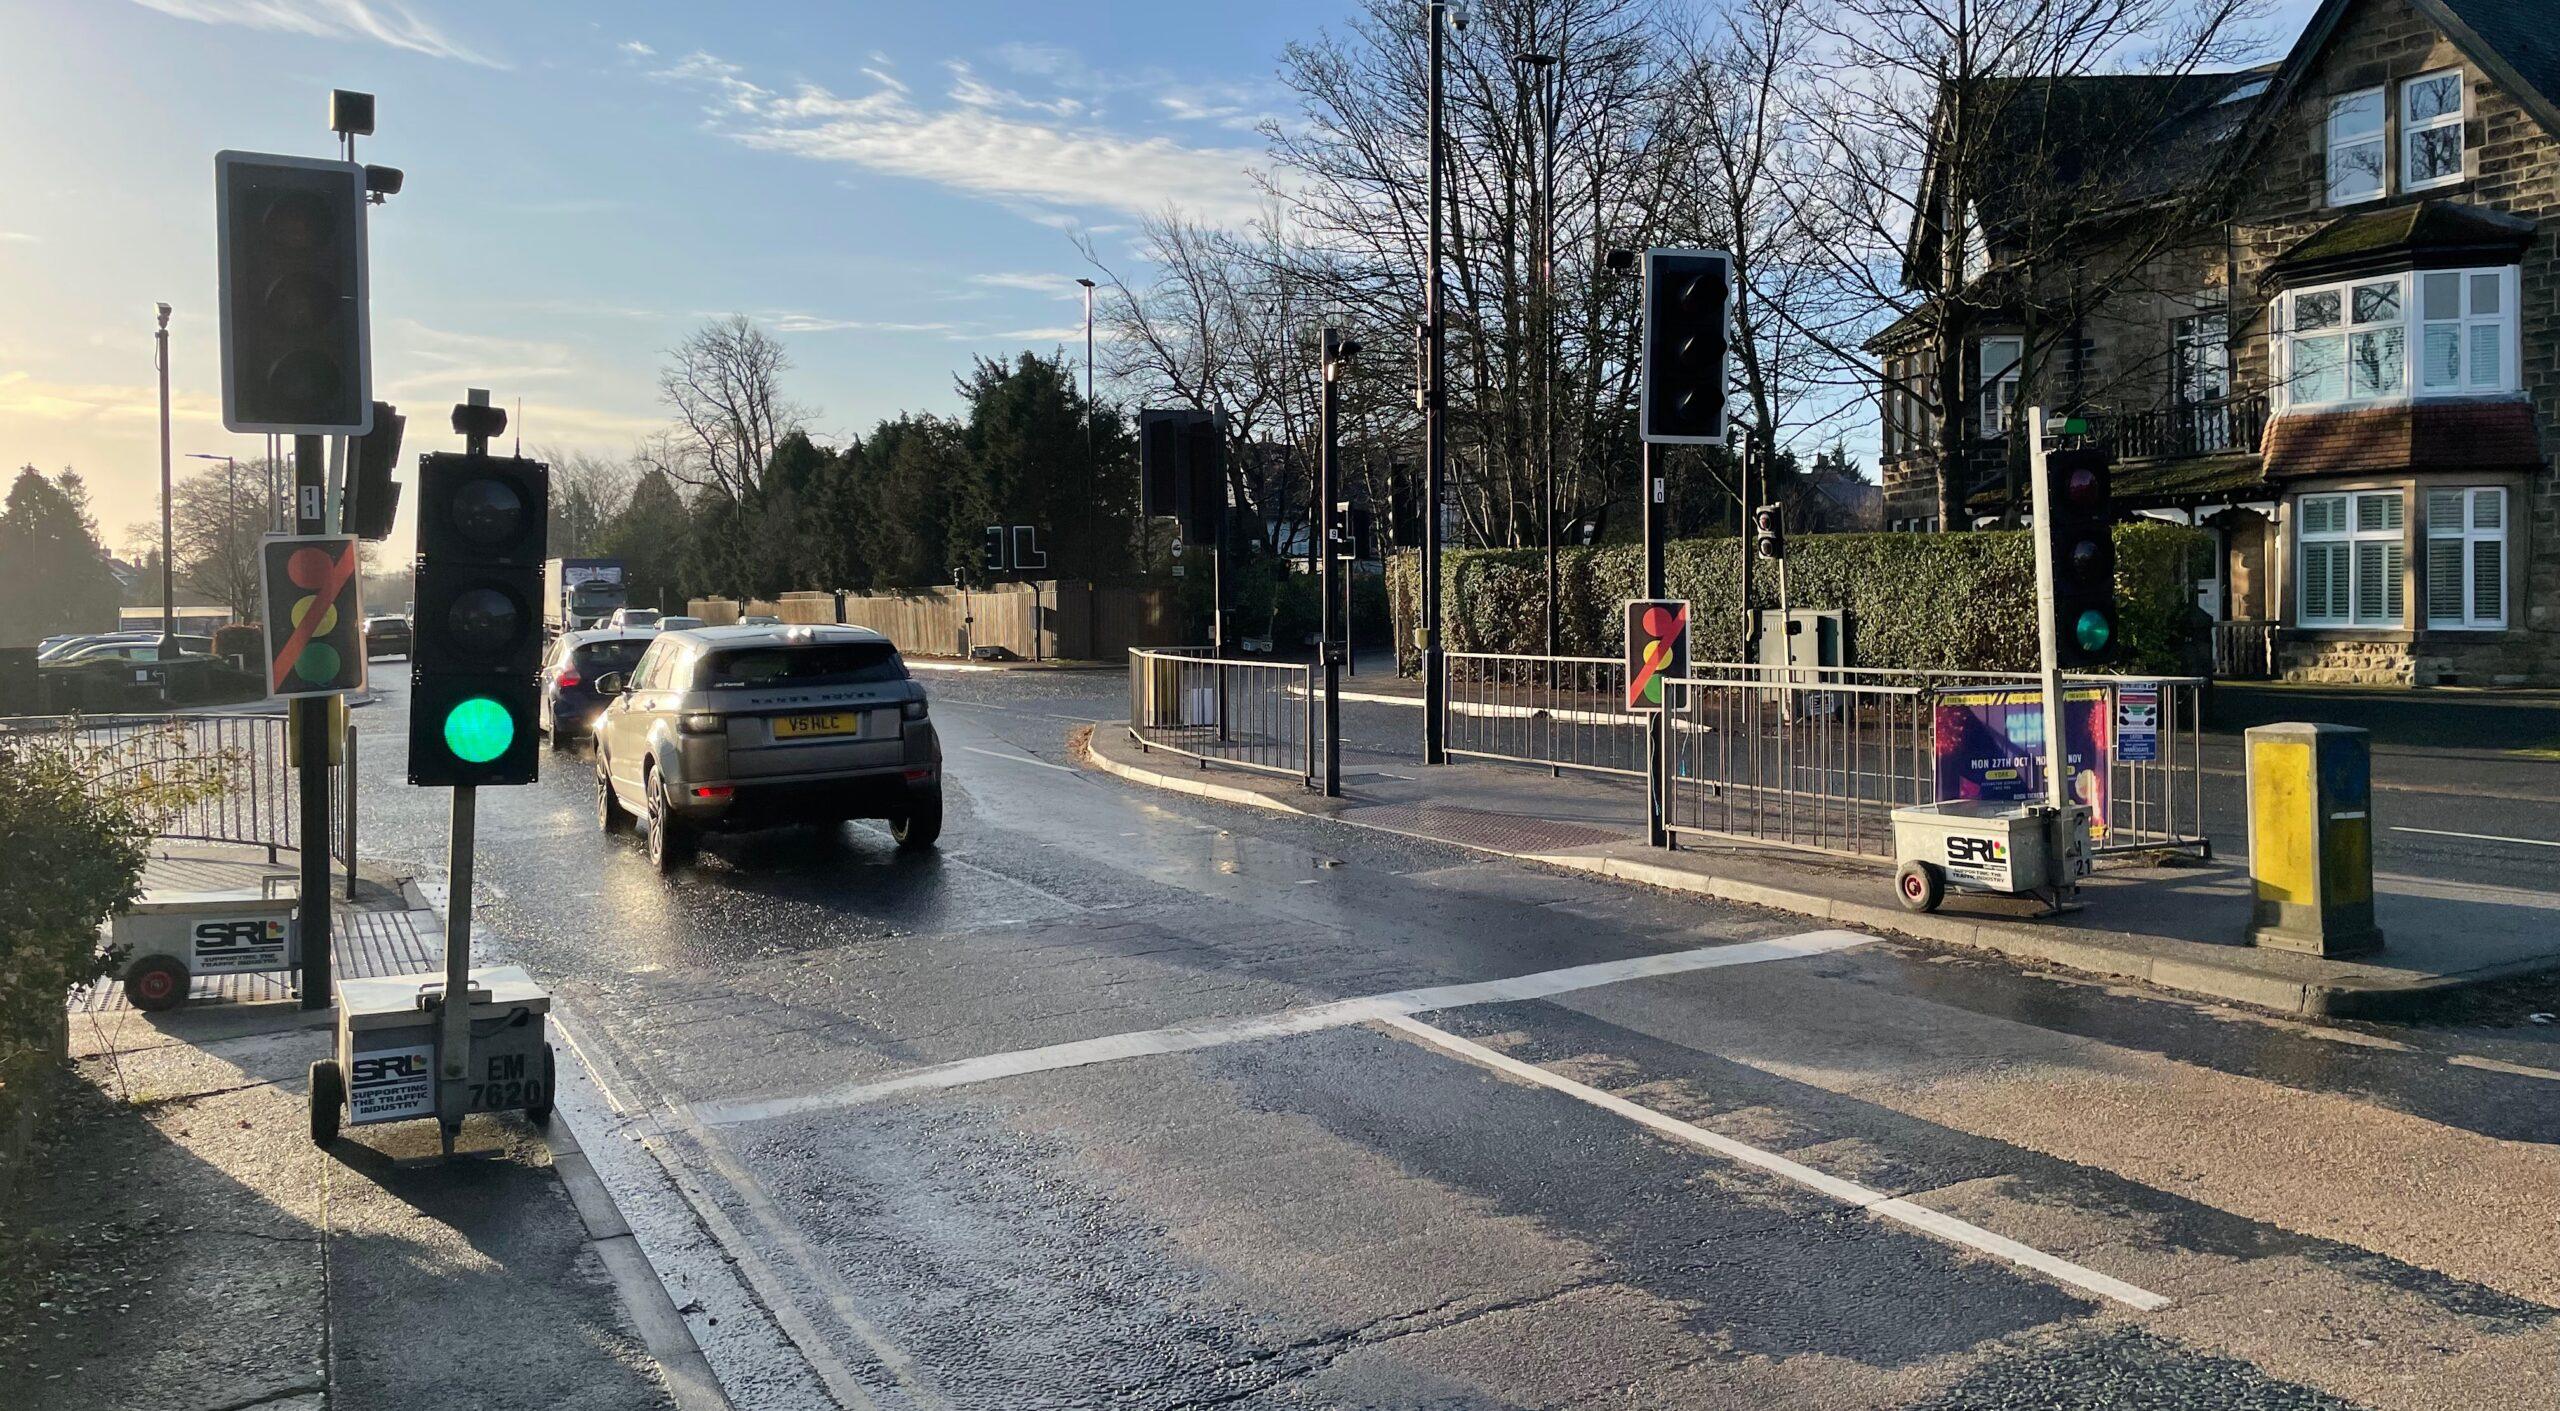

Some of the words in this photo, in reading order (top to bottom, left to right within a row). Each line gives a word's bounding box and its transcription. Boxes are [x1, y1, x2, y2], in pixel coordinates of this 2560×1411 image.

[304, 487, 313, 517] 11
[1657, 480, 1663, 502] 10
[1971, 759, 1989, 769] MON
[1992, 758, 2011, 768] 27TH
[2013, 756, 2029, 767] OCT
[2036, 755, 2049, 765] MO
[2068, 754, 2082, 763] NOV
[1947, 836, 2007, 864] SRL
[1976, 875, 2005, 883] INDUSTRY
[196, 921, 284, 948] SRL
[352, 1055, 427, 1081] SRL
[488, 1053, 525, 1081] EM
[352, 1084, 428, 1099] SUPPORTING
[352, 1098, 375, 1107] THE
[379, 1092, 428, 1103] TRAFFIC
[468, 1080, 540, 1109] 7620
[360, 1101, 419, 1114] INDUSTRY
